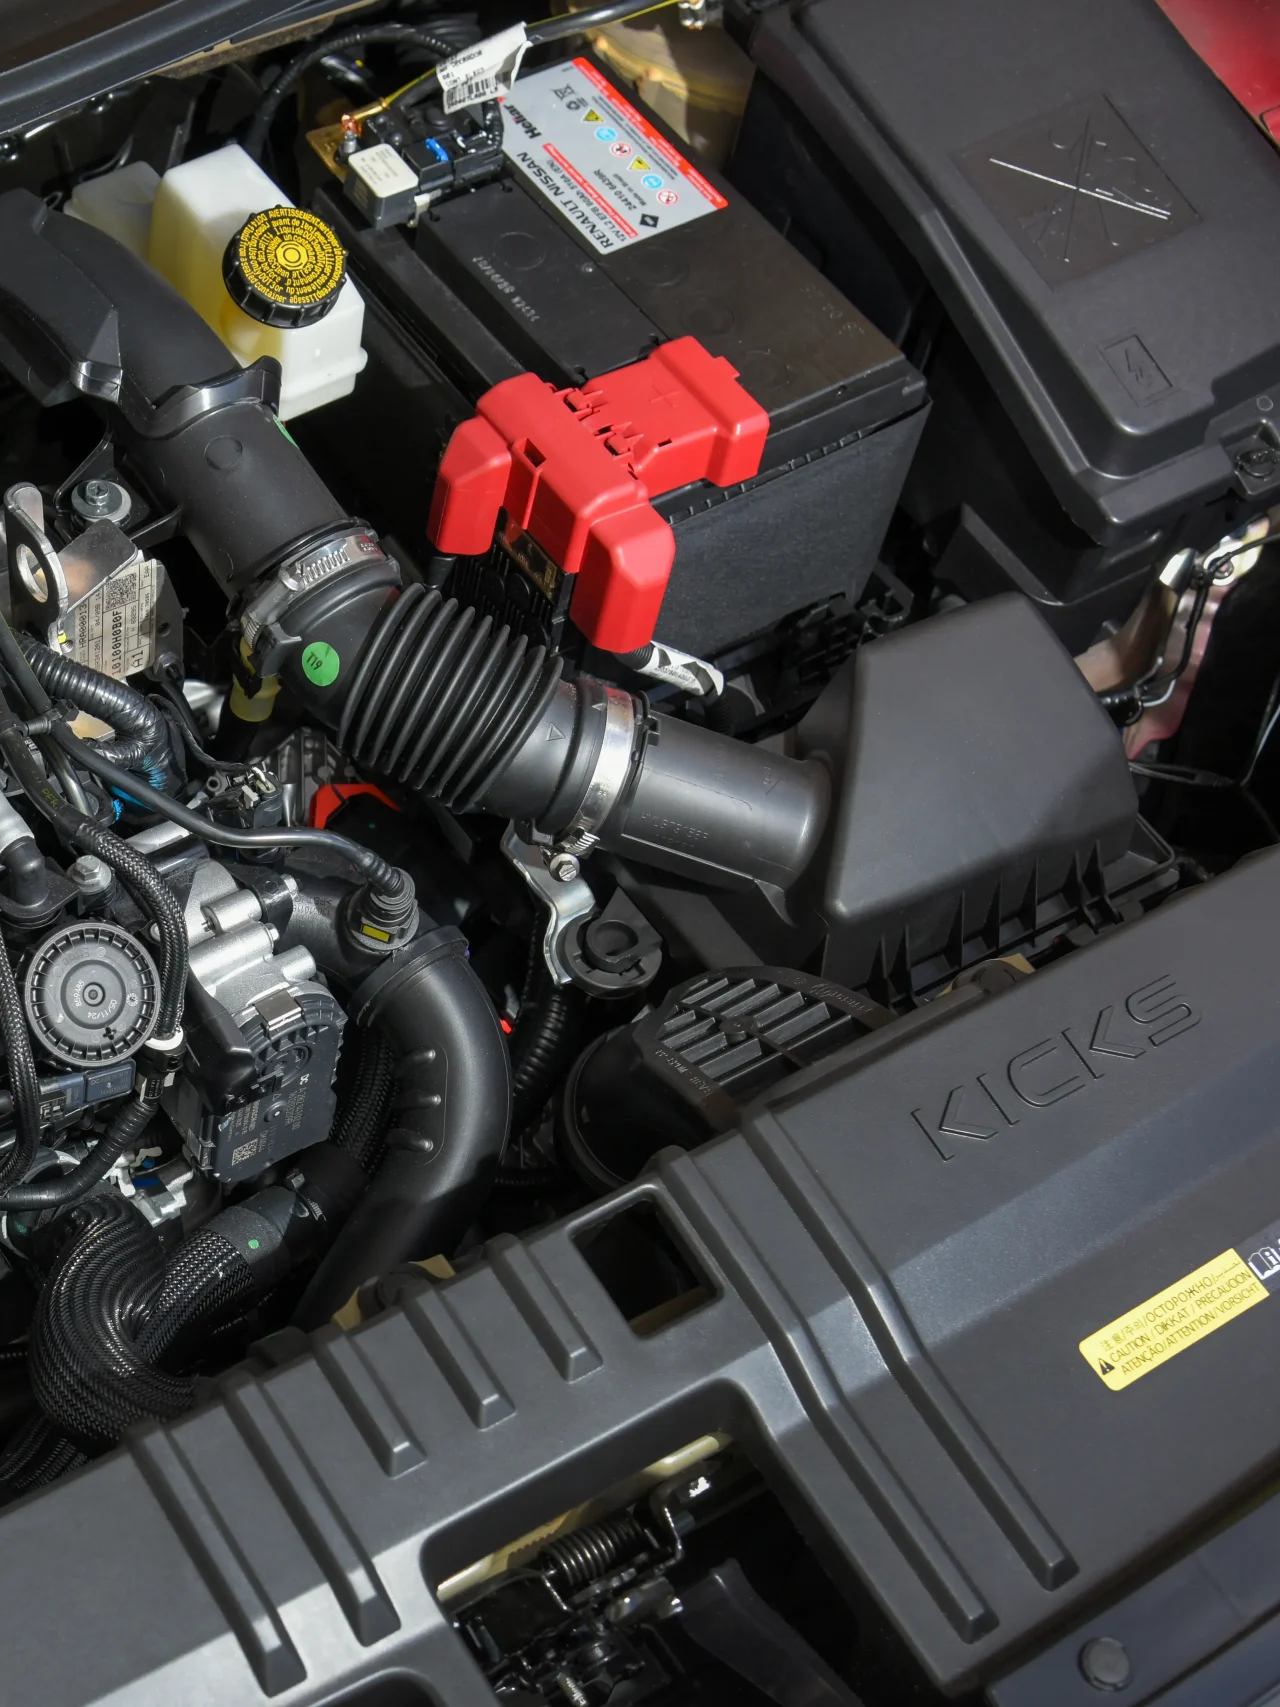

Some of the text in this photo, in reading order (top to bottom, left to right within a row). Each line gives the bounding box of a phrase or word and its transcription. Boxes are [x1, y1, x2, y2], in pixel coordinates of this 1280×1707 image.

[501, 102, 542, 139] Heliar
[517, 151, 614, 248] RENAULT NISSAN
[131, 650, 144, 669] A1
[306, 651, 323, 670] T19
[87, 999, 118, 1020] 05/11/24
[911, 974, 1202, 1162] KICKS
[1109, 1333, 1151, 1363] CAUTION
[1154, 1306, 1190, 1335] DIKKAT
